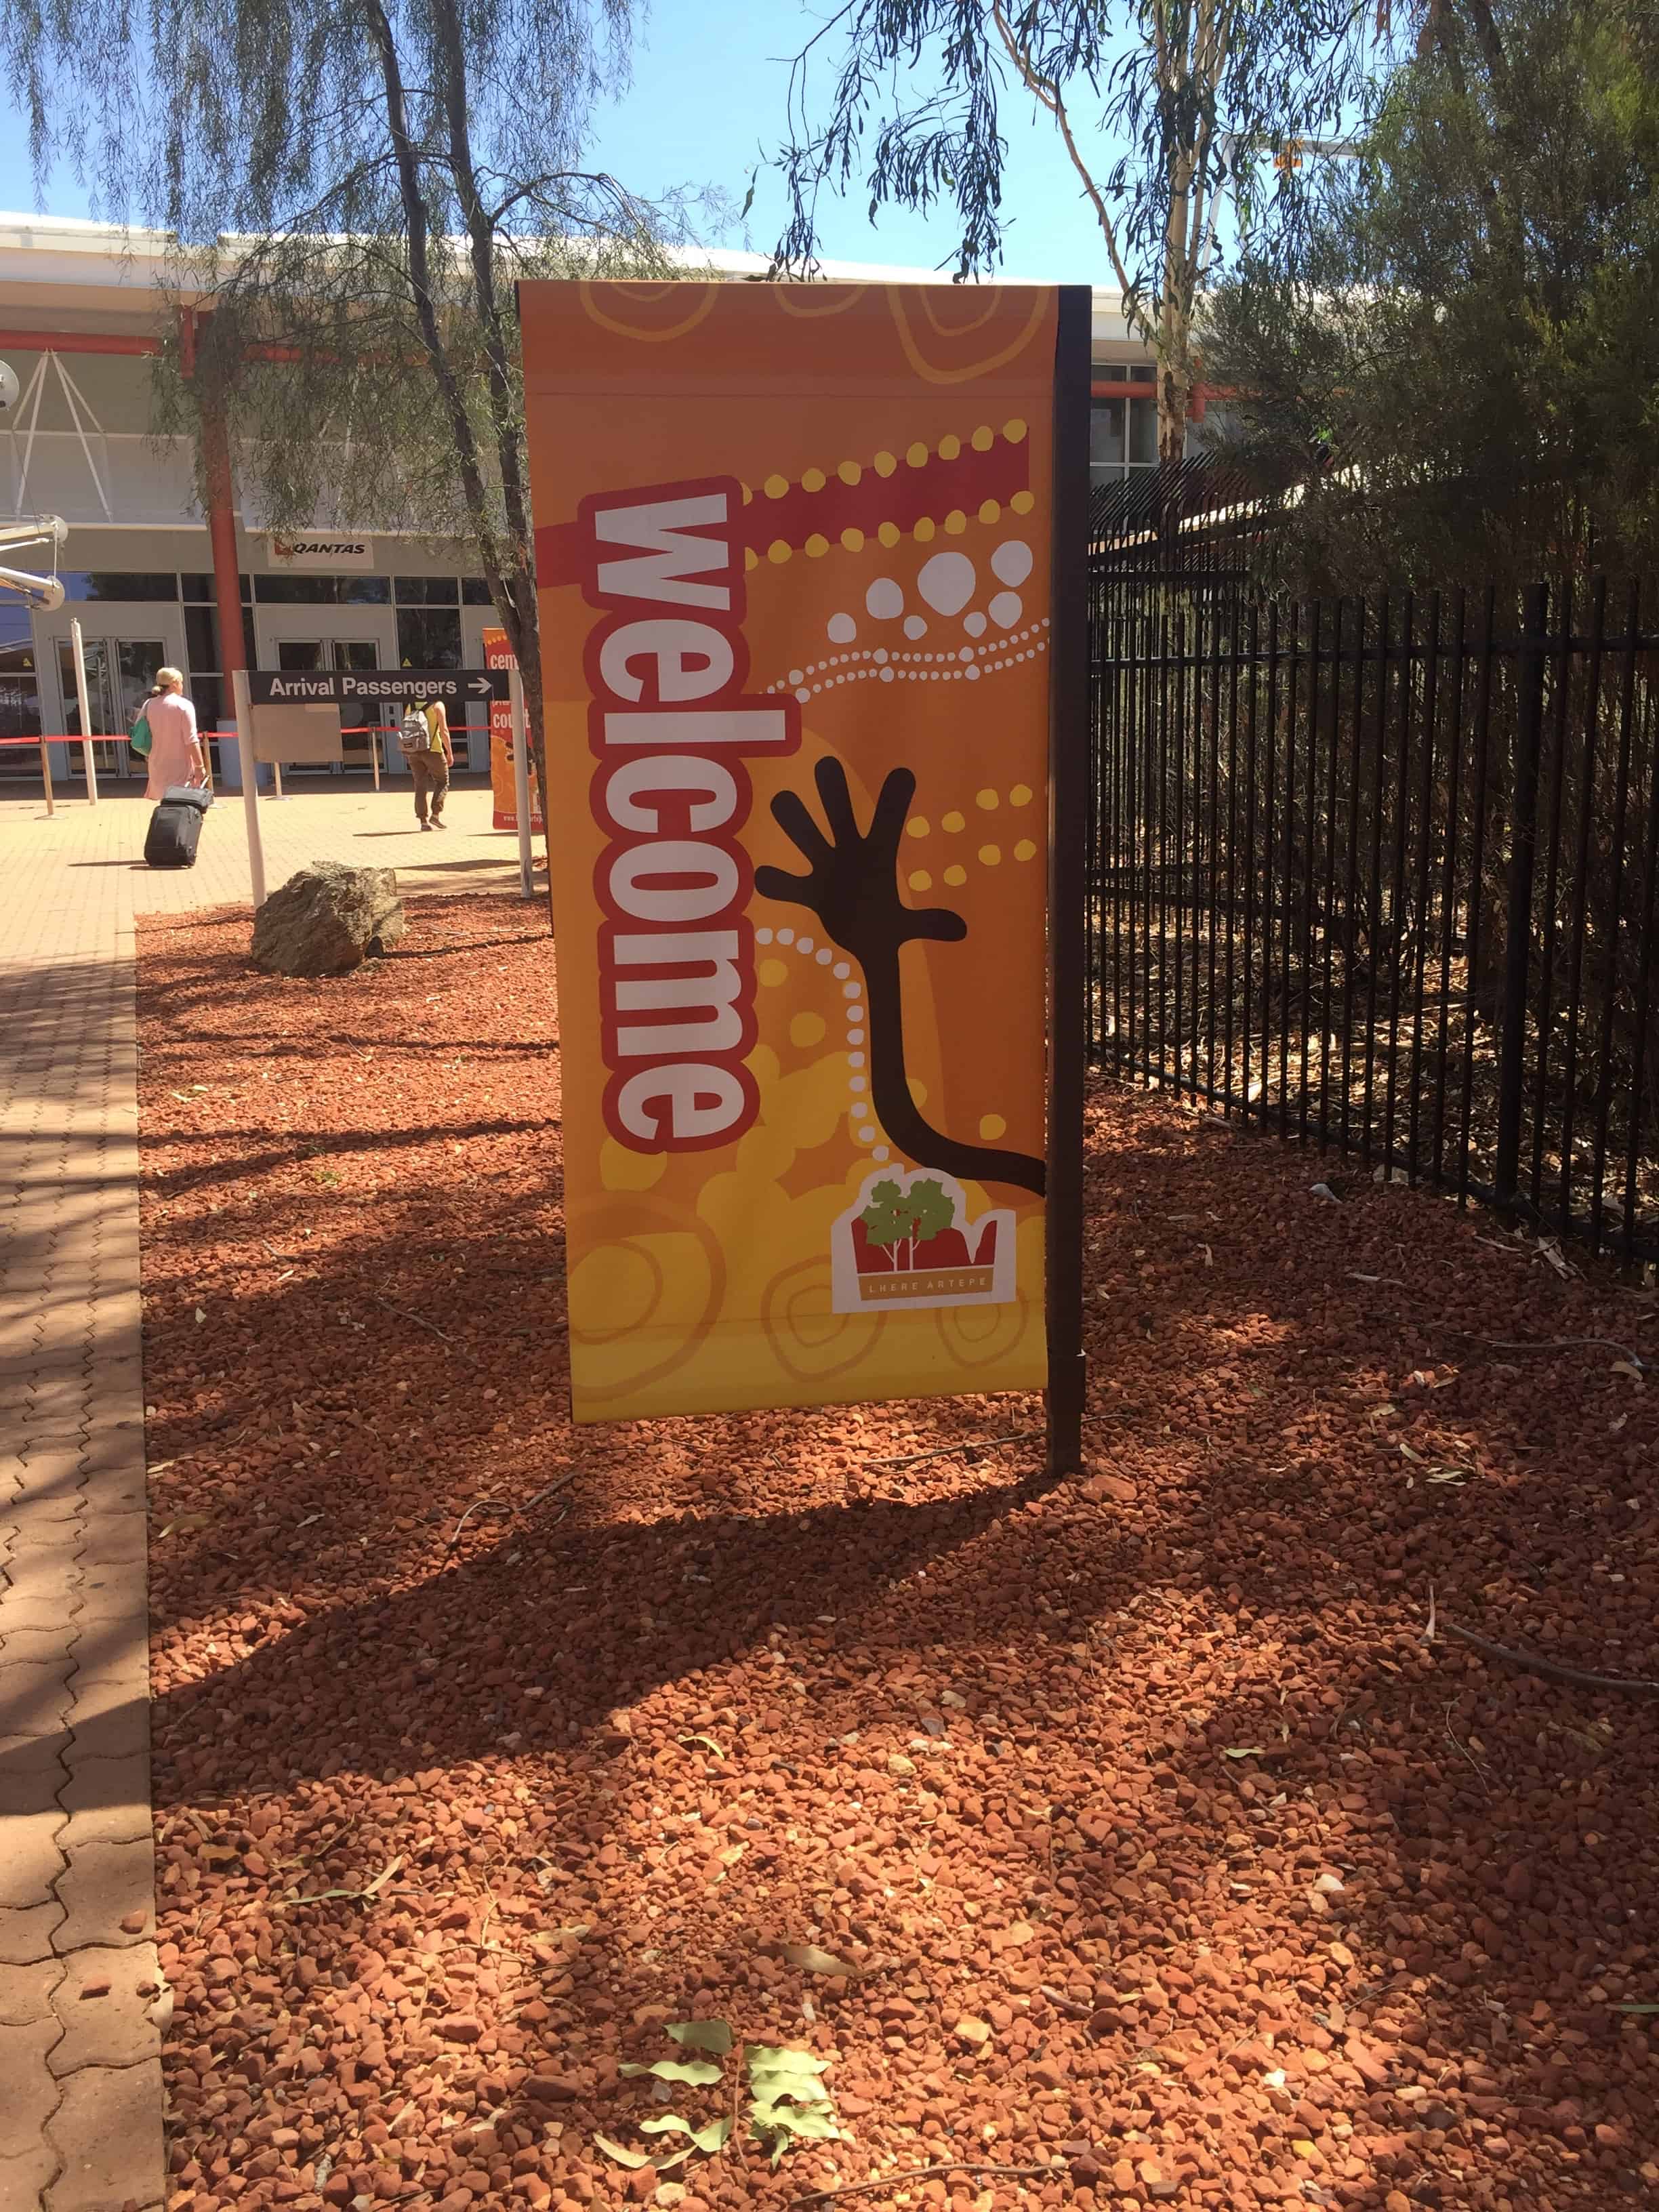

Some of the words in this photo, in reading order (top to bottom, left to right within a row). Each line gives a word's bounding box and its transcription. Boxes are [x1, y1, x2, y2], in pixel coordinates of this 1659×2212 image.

[294, 543, 365, 554] QANTAS
[270, 677, 335, 696] Arrival
[342, 676, 457, 699] Passengers
[594, 492, 786, 1141] welcome
[869, 1282, 919, 1293] LHERE
[926, 1277, 987, 1290] ARTEPE
